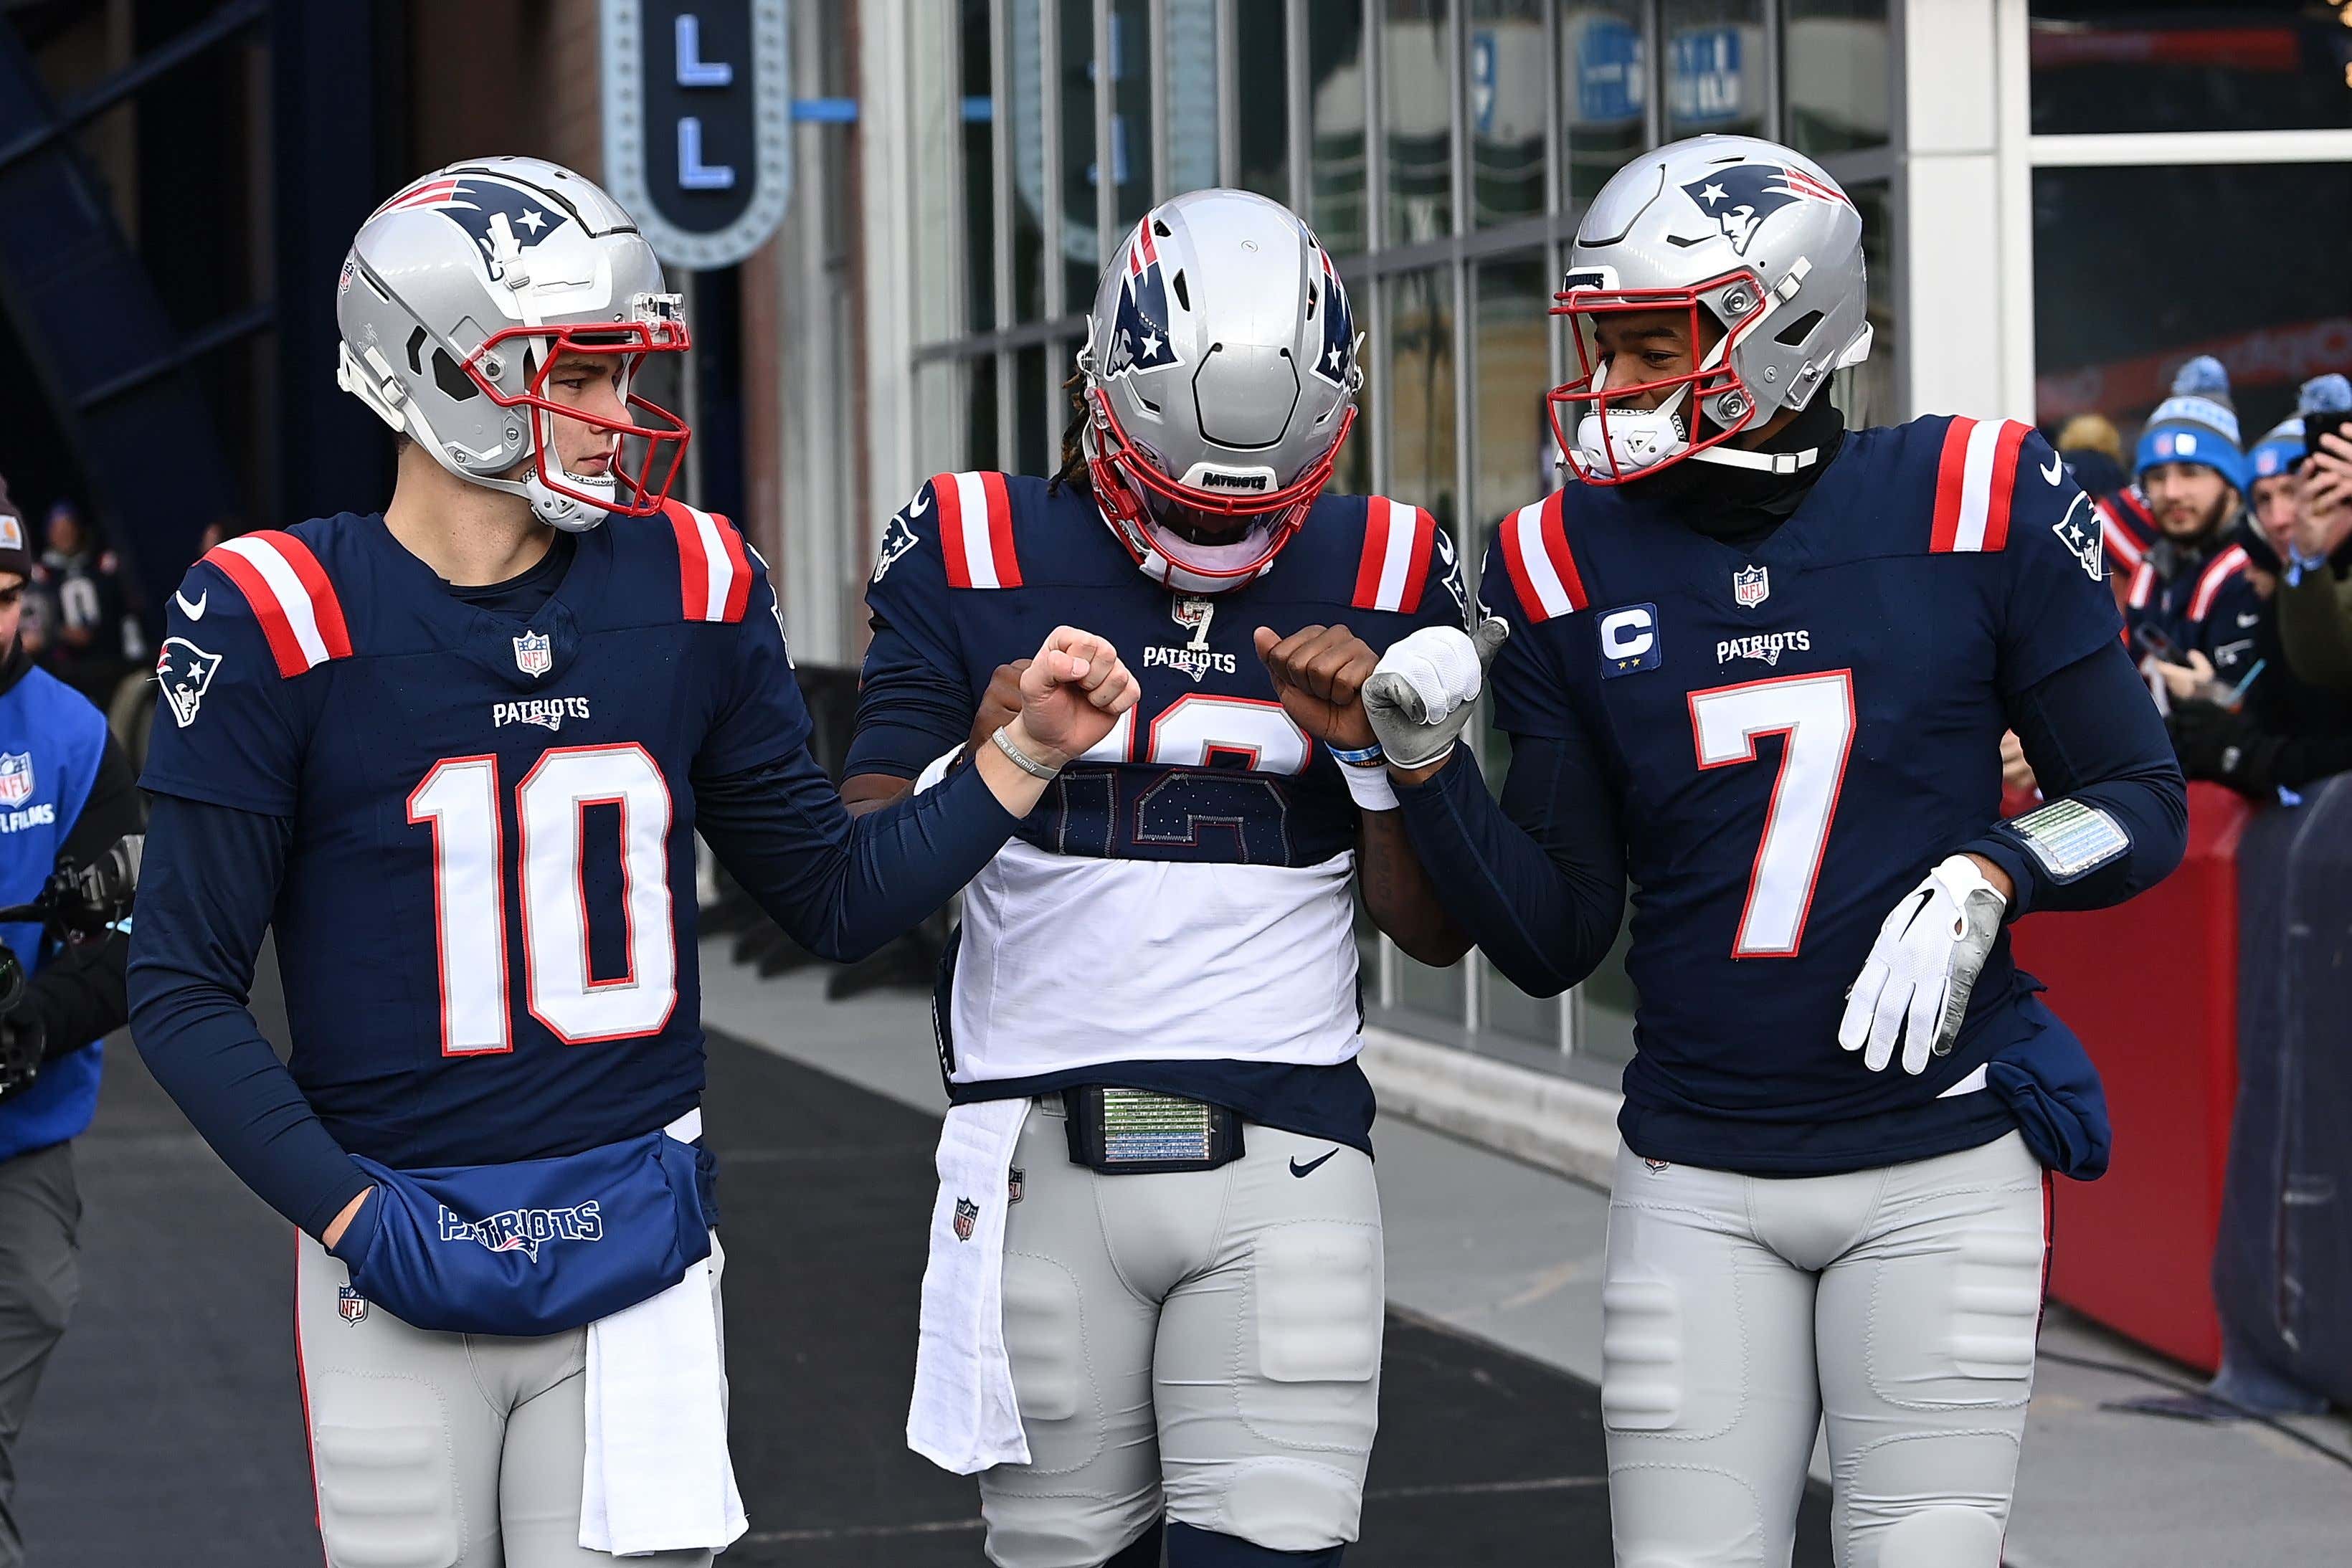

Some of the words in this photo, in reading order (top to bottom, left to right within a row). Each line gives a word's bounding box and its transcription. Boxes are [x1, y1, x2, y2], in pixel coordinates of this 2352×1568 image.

[1202, 472, 1267, 490] PATRIOTS
[1740, 583, 1763, 599] NFL
[1182, 601, 1214, 652] 7
[1601, 609, 1654, 660] C
[522, 651, 547, 668] NFL
[1143, 646, 1236, 674] PATRIOTS
[1717, 629, 1811, 664] PATRIOTS
[493, 697, 590, 728] PATRIOTS
[9, 803, 55, 832] FILMS
[1687, 667, 1857, 959] 7
[406, 741, 678, 1058] 10
[438, 1200, 603, 1252] PATRIOTS
[341, 1299, 362, 1318] NFL
